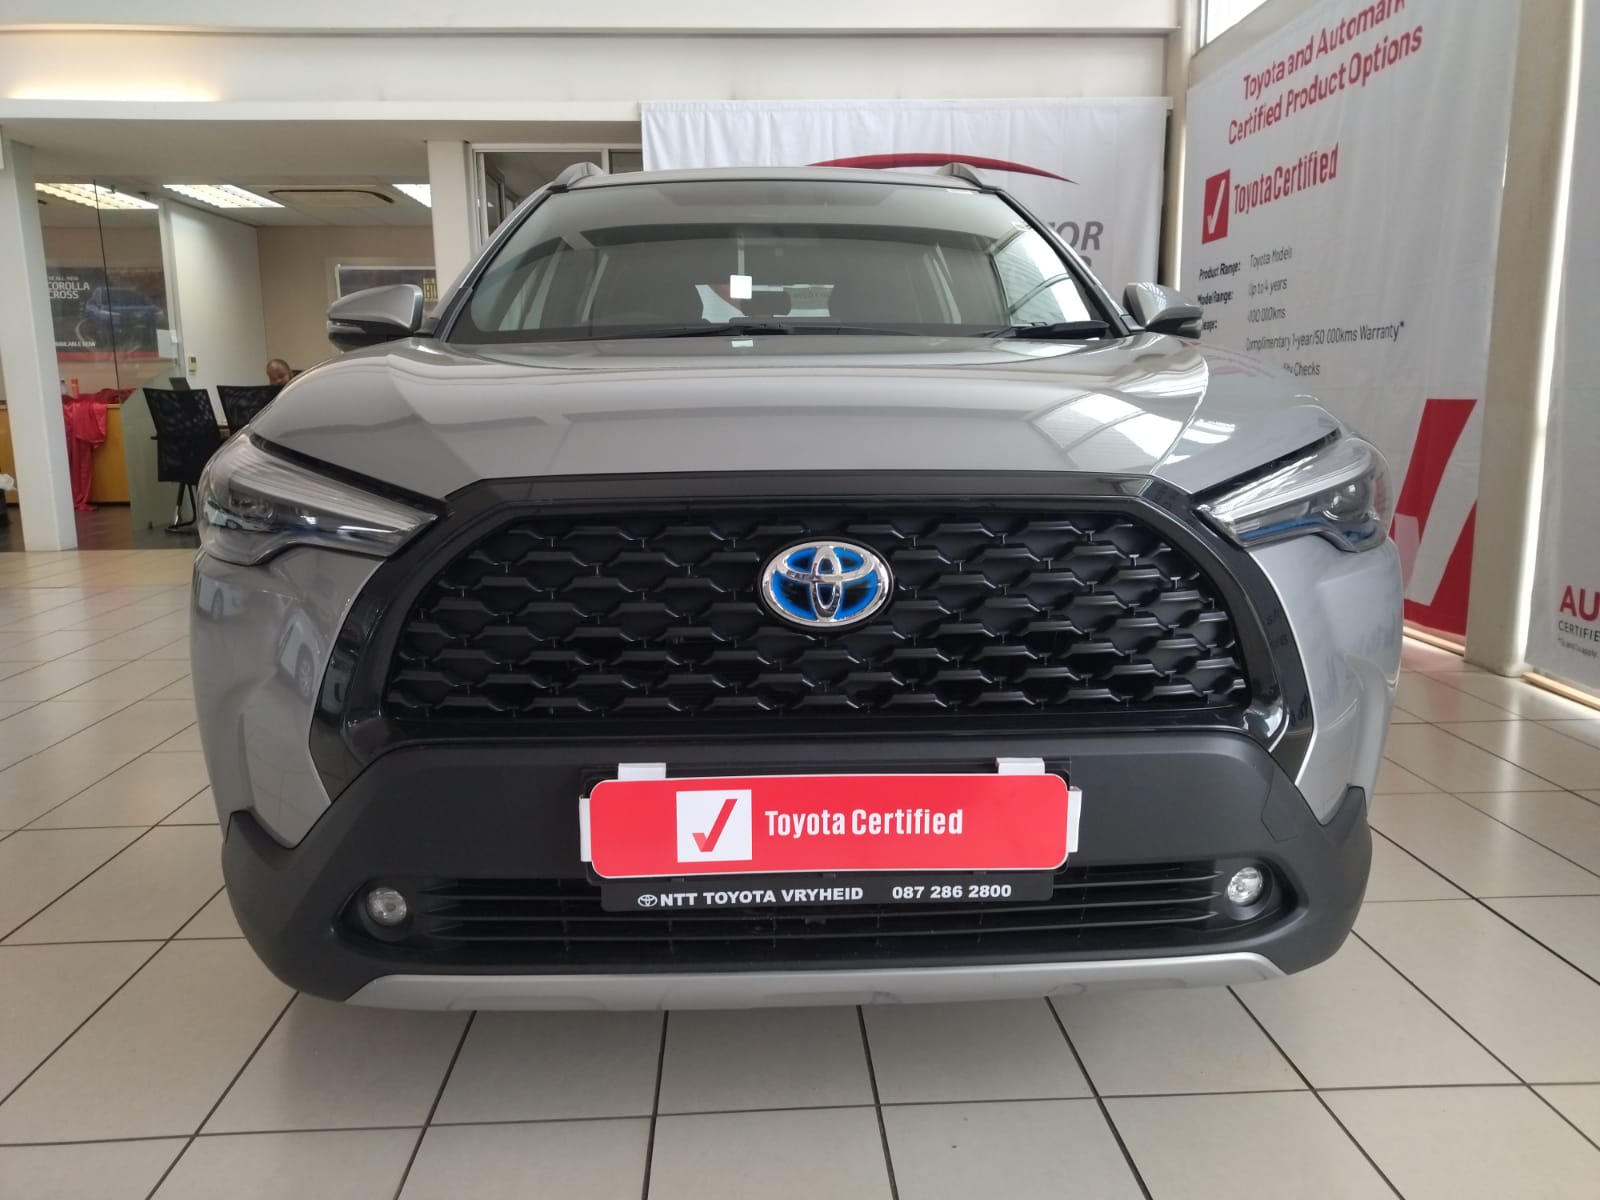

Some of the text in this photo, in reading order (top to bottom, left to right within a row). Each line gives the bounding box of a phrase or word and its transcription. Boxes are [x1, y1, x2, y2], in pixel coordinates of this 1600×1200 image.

[1243, 60, 1285, 100] Toyota
[1287, 34, 1315, 76] and
[1228, 25, 1424, 145] Certified Product Options
[1250, 253, 1270, 270] Toyota
[48, 281, 90, 291] COROLLA
[1270, 279, 1287, 295] years
[48, 291, 80, 299] CROSS
[1294, 361, 1320, 377] Checks
[765, 808, 963, 839] Toyota Certified
[660, 884, 1012, 907] NTT TOYOTA VRYHEID 087 286 2800
